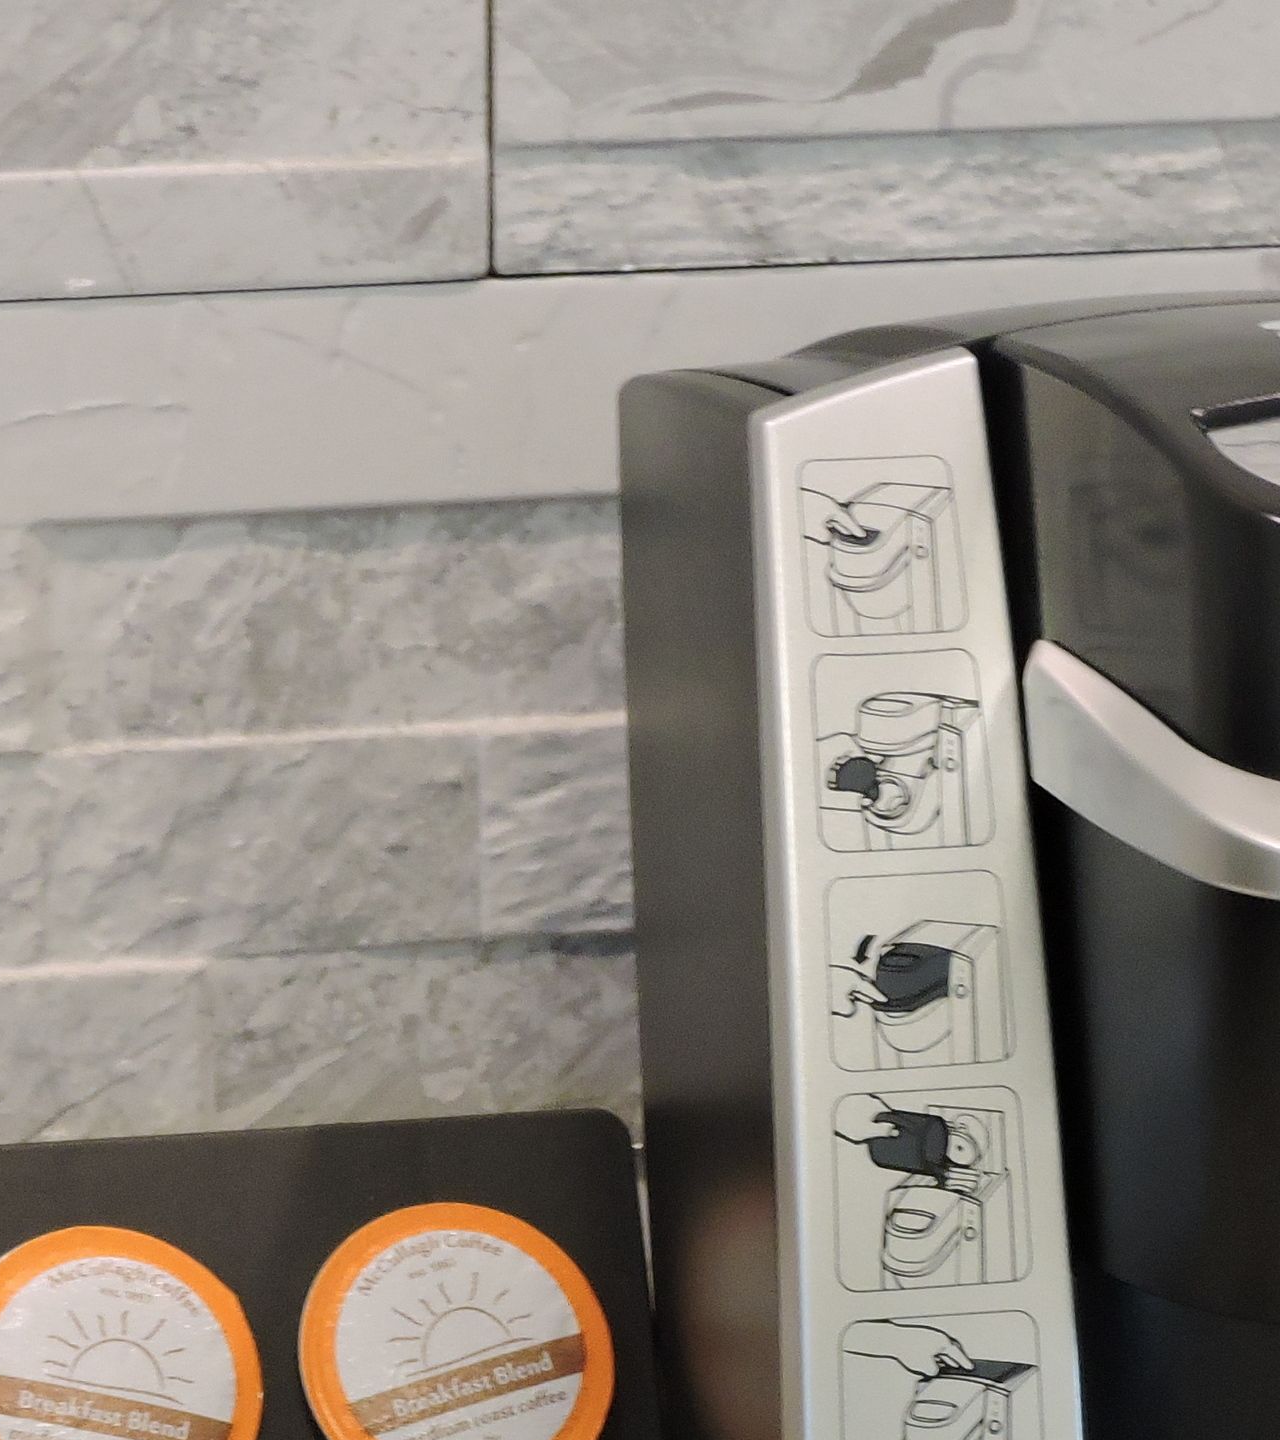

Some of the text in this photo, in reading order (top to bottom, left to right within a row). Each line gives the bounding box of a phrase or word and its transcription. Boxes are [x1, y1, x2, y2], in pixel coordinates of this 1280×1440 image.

[393, 1350, 555, 1417] Breakfast Blend
[17, 1389, 192, 1440] Breakfast Blend
